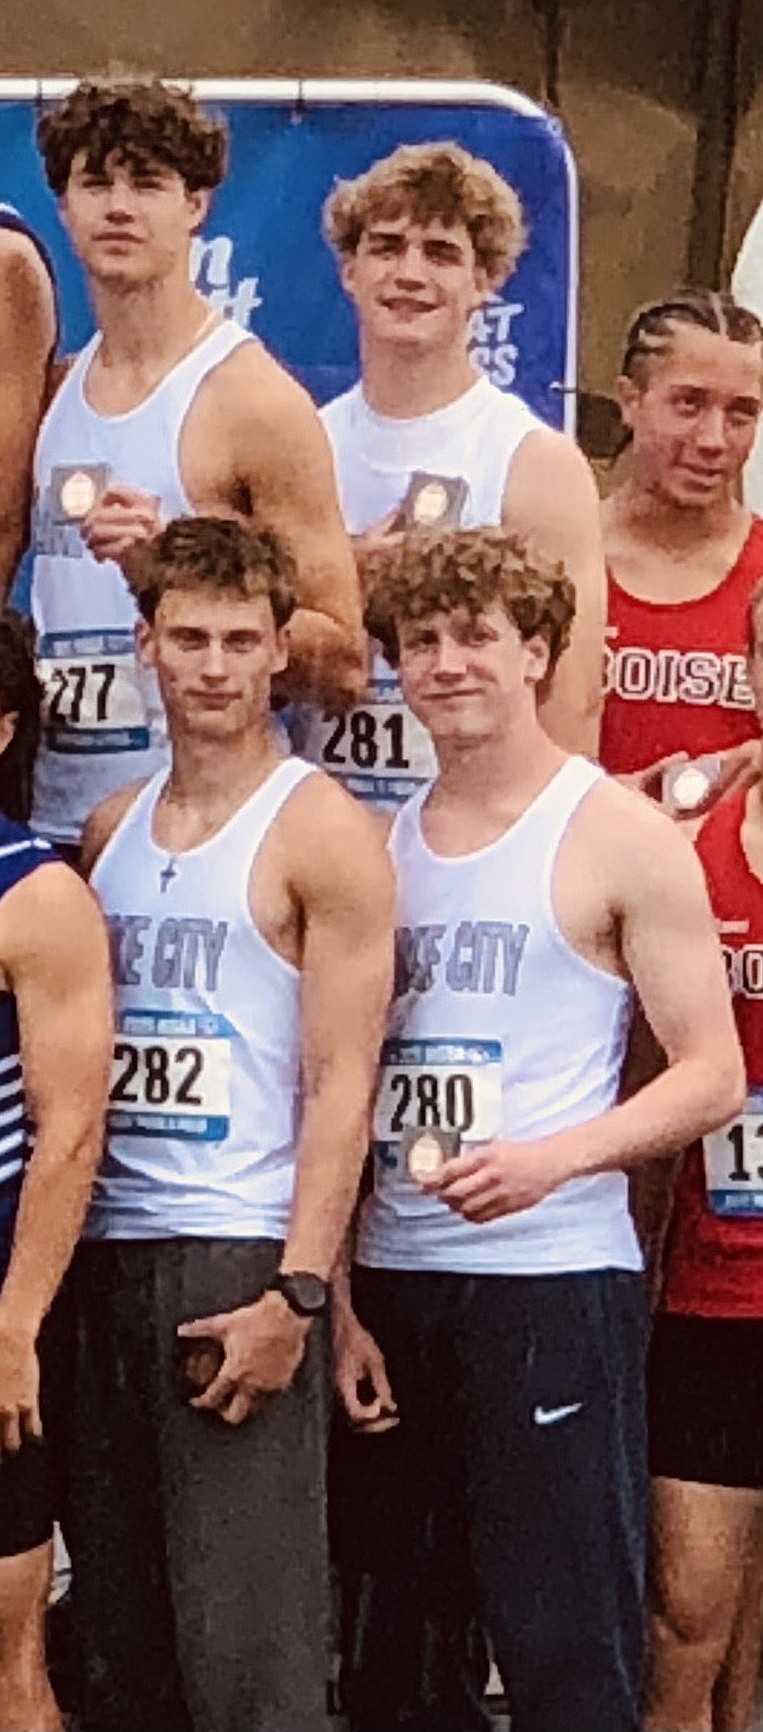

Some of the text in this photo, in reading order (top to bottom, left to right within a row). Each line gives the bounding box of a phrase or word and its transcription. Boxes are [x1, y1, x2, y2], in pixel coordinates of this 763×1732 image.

[322, 710, 409, 769] 281
[151, 917, 228, 991] CITY
[446, 920, 530, 996] CITY
[108, 1043, 204, 1105] 282
[390, 1073, 474, 1133] 280
